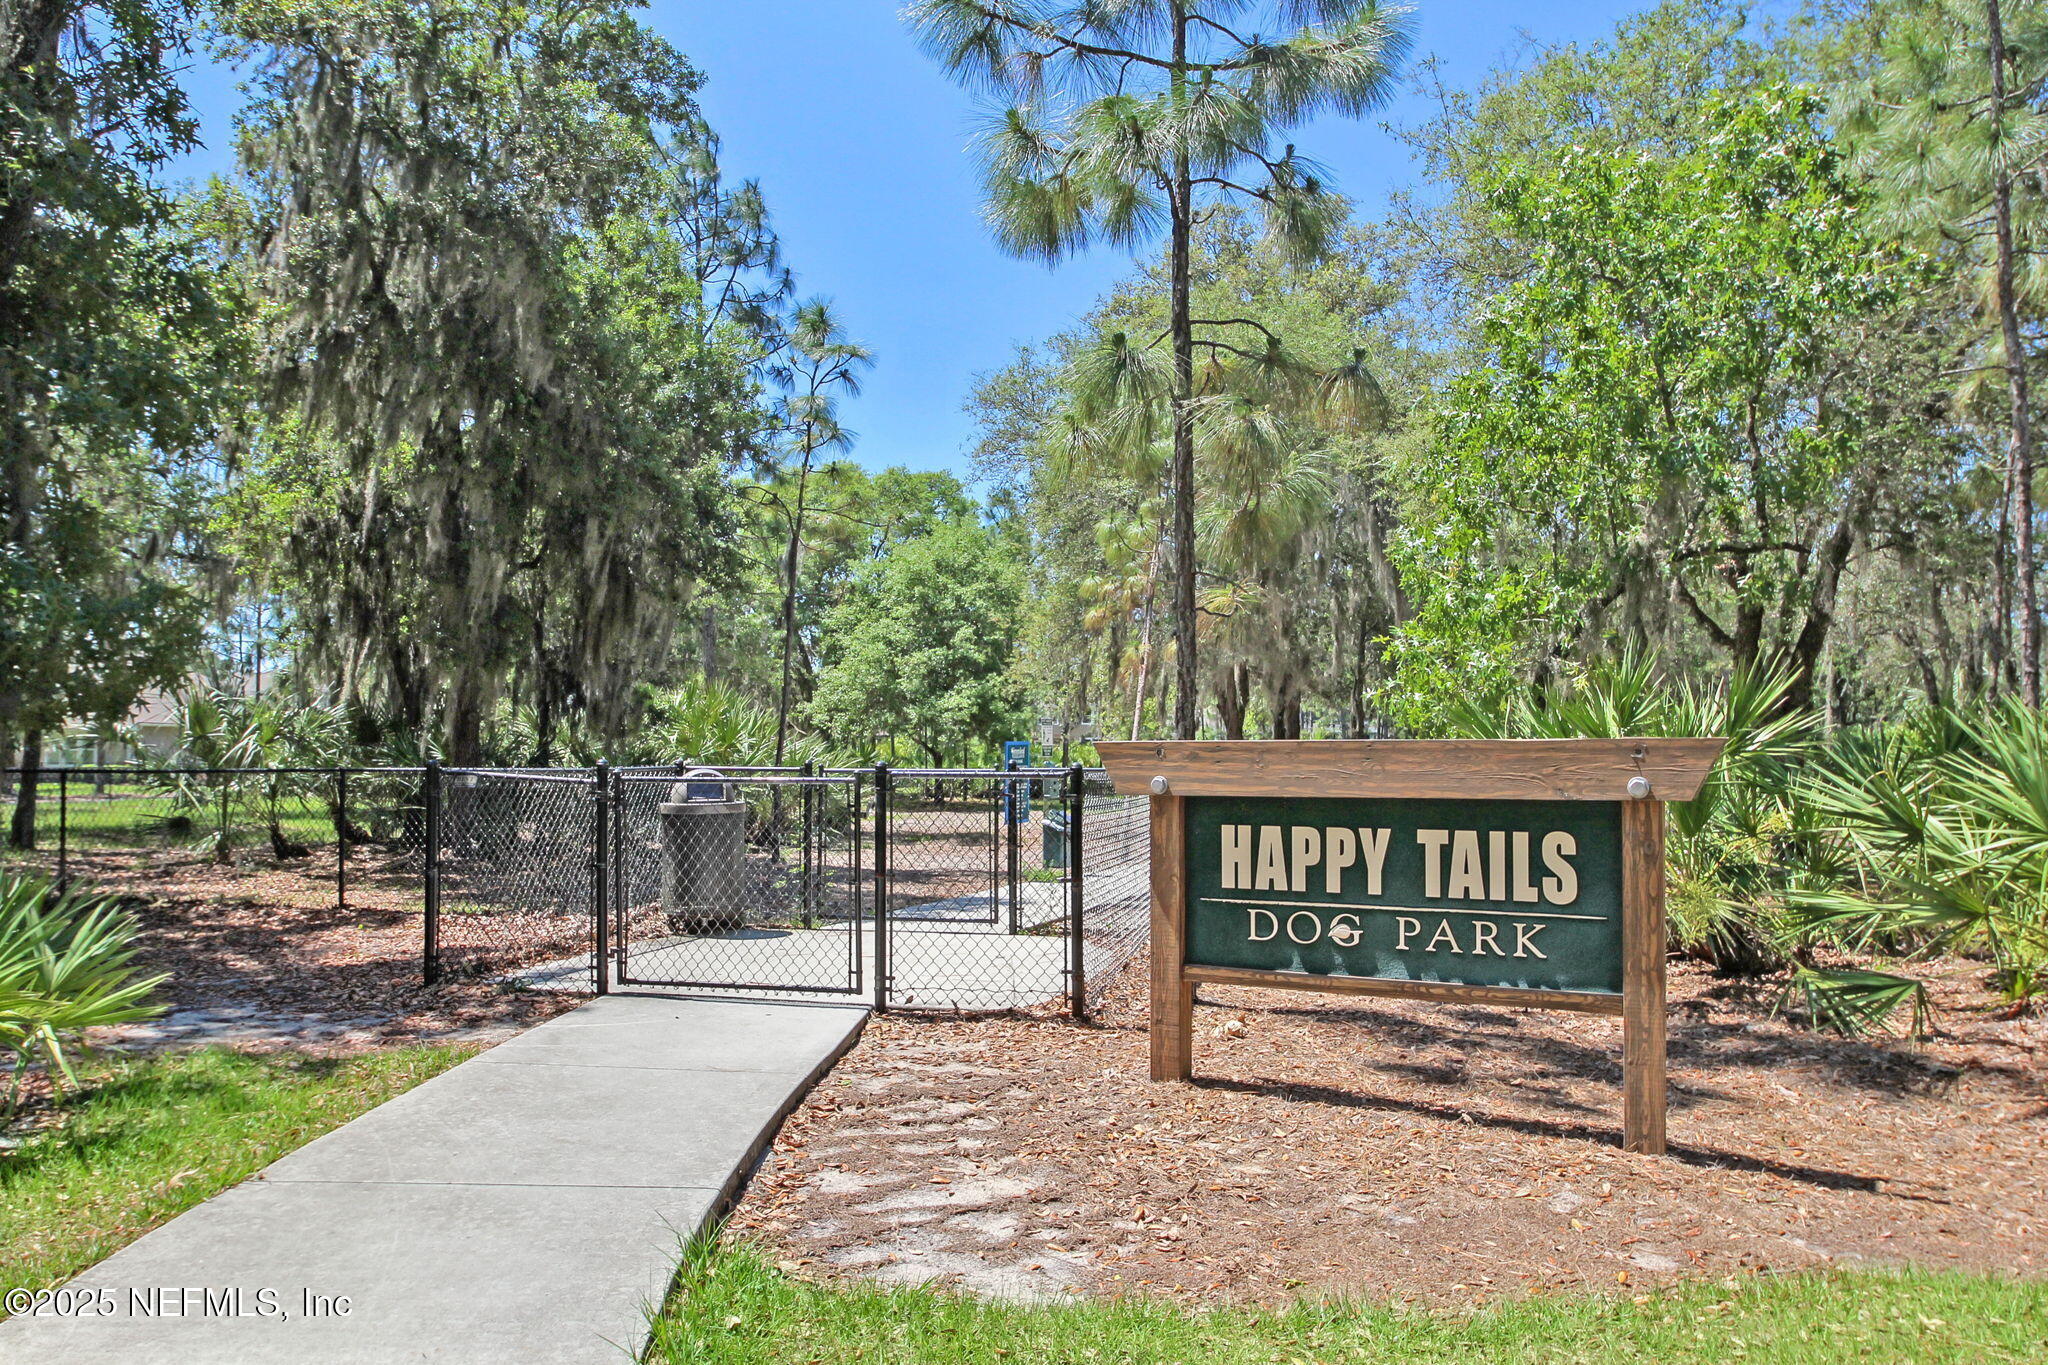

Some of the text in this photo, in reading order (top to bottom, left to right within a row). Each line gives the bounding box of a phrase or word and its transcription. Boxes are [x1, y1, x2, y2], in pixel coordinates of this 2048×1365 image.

[1221, 824, 1578, 905] HAPPY TAILS
[1247, 908, 1547, 959] DOG PARK
